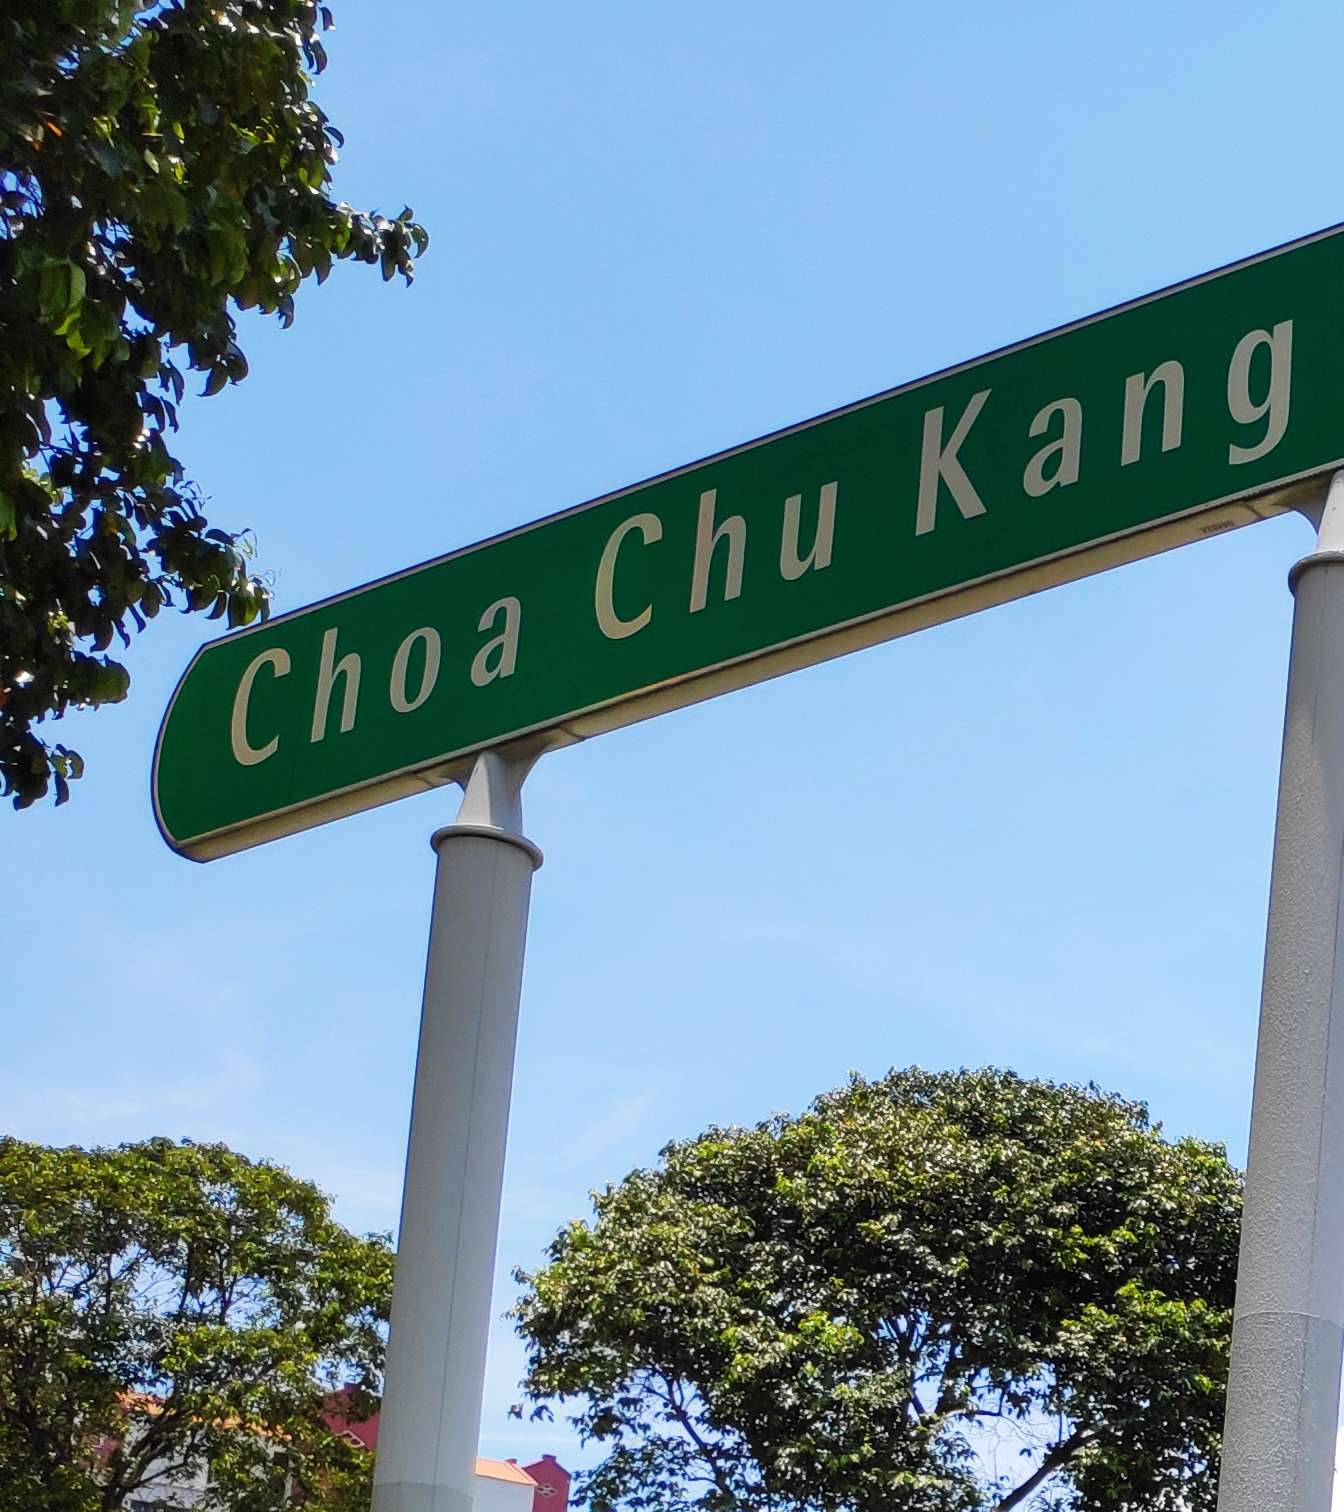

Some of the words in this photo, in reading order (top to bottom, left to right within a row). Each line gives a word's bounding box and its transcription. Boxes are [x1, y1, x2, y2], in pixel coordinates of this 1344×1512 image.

[230, 595, 523, 767] Choa
[594, 480, 839, 641] Chu
[914, 318, 1296, 537] Kang
